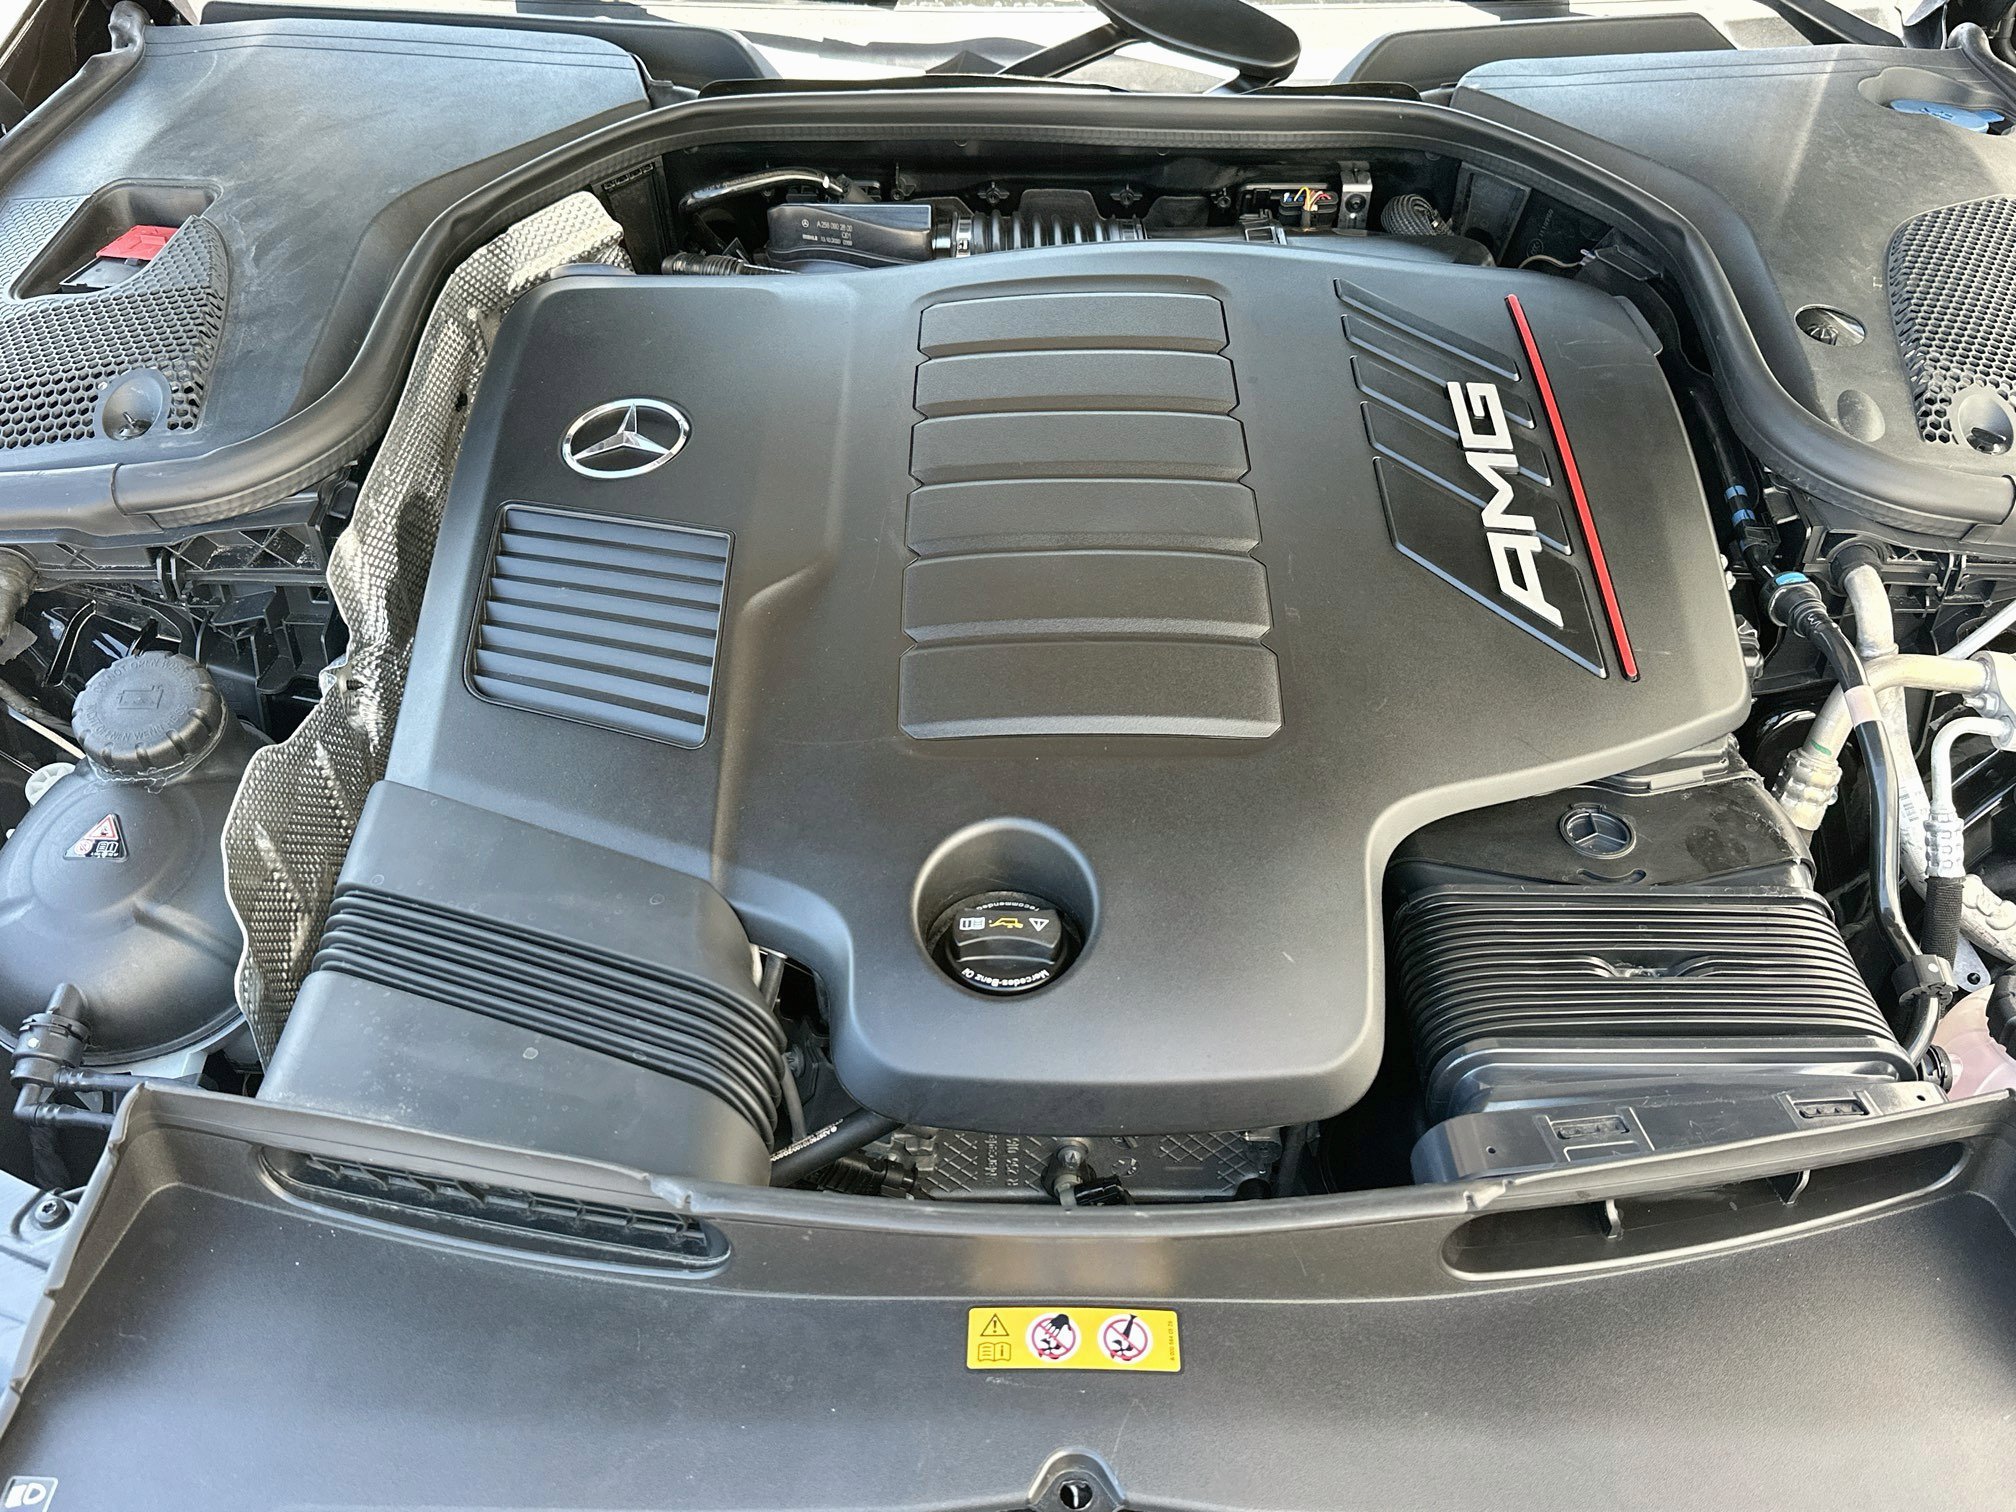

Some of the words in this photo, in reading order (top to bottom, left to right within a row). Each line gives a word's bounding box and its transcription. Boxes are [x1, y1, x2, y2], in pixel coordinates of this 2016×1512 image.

[1447, 381, 1564, 629] AMG
[961, 967, 975, 978] Oil
[976, 969, 1050, 987] Mercedes-Benz
